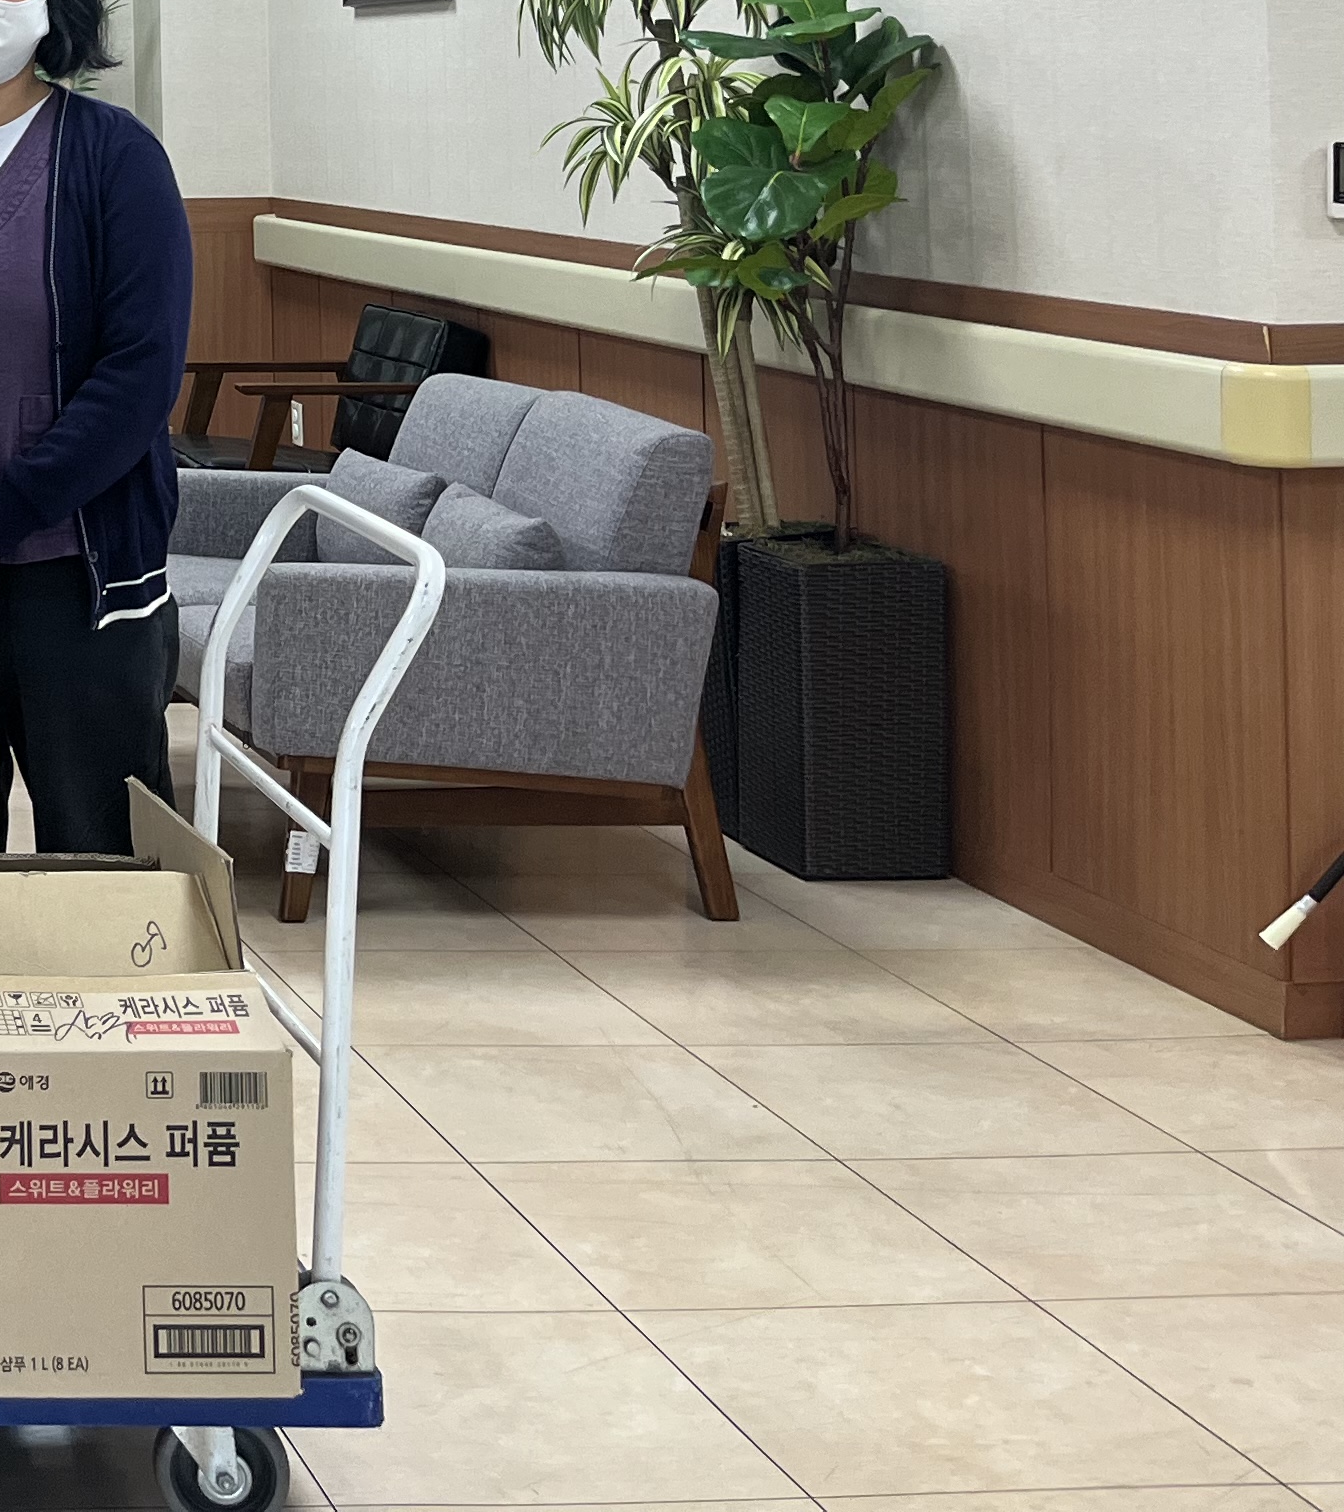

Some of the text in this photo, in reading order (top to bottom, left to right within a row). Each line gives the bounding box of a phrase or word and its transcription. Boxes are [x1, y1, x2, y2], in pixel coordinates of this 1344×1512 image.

[118, 994, 250, 1019] 케라시스 퍼퓸
[133, 1022, 232, 1033] 스위트&플라워리
[19, 1075, 49, 1090] 애경
[0, 1120, 240, 1168] 케라시스 퍼퓸
[8, 1179, 160, 1199] 스위트&플라워리
[172, 1291, 246, 1311] 6085070
[0, 1356, 26, 1373] 샴푸
[31, 1358, 36, 1371] 1
[41, 1358, 48, 1371] L
[68, 1355, 89, 1372] EA)
